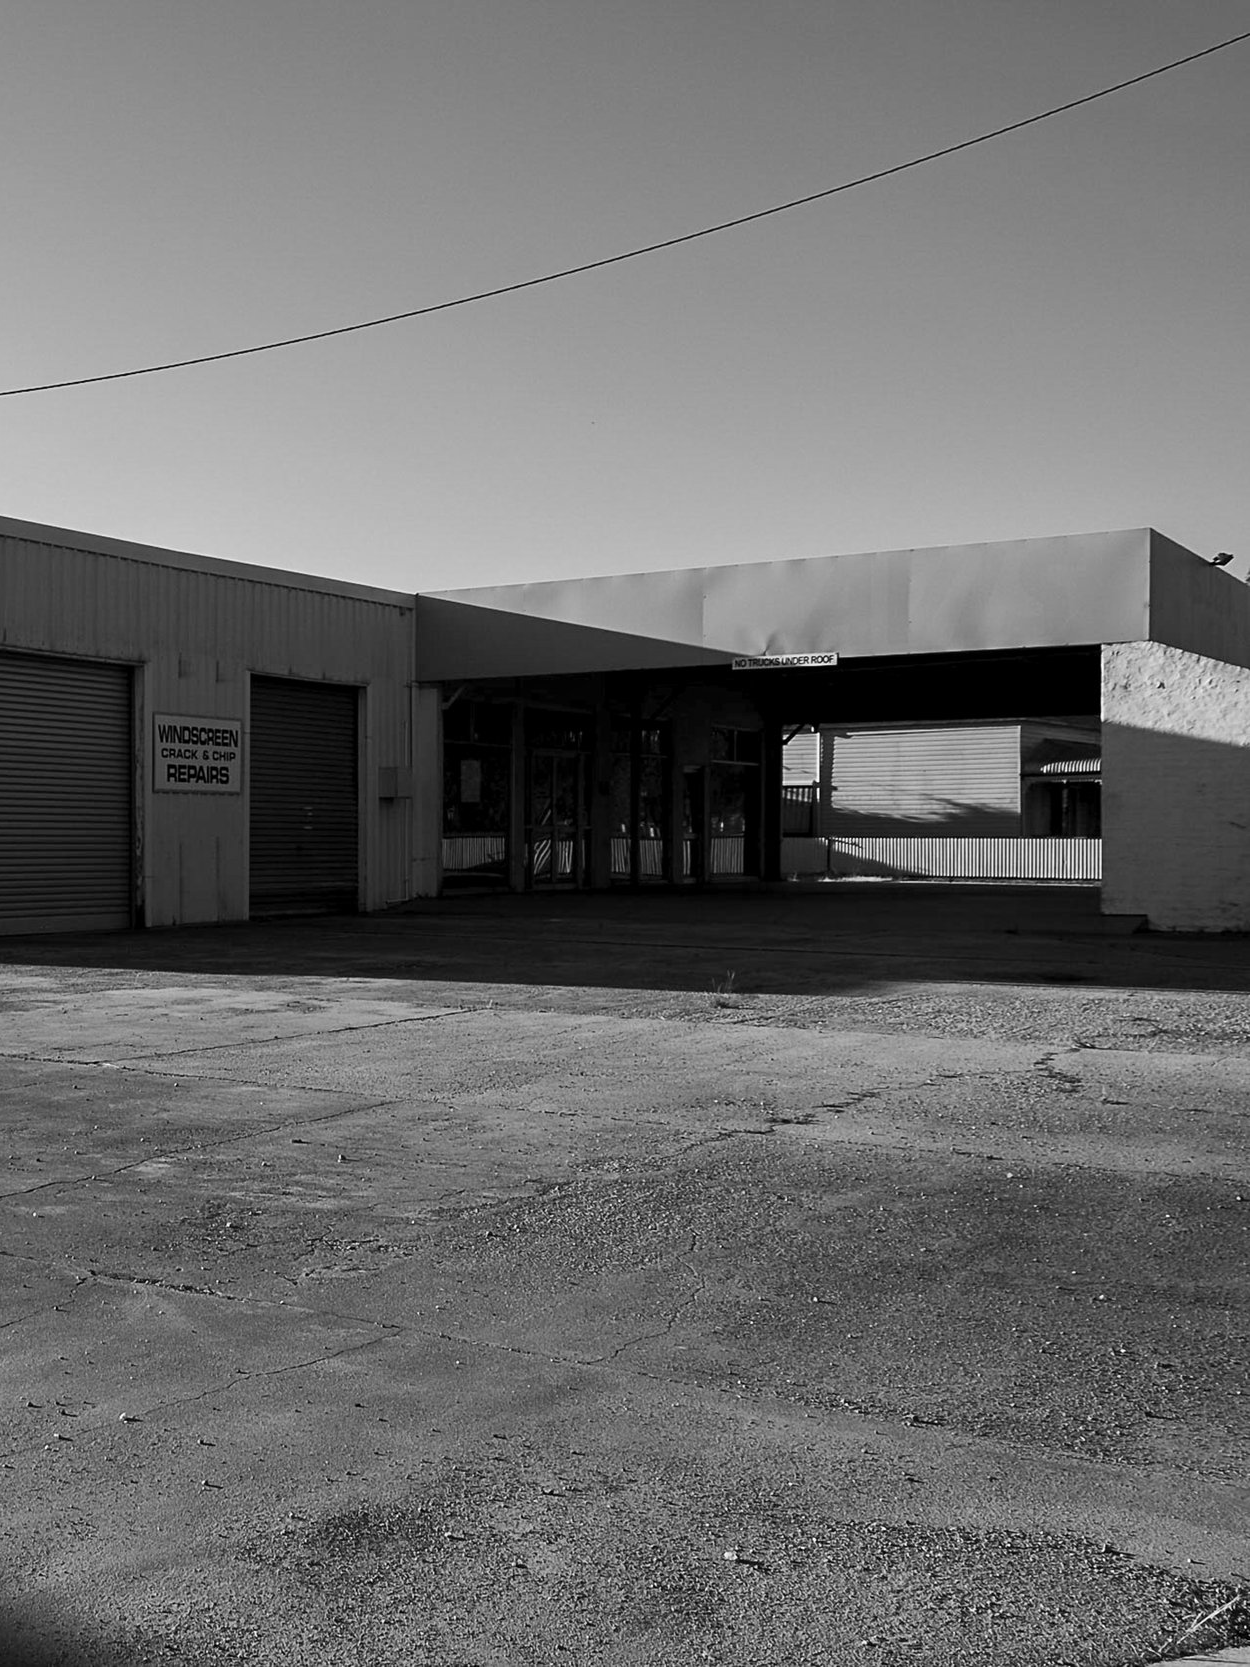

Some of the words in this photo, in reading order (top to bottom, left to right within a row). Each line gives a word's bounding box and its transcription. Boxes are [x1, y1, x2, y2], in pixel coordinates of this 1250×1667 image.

[734, 659, 747, 668] NO
[748, 657, 780, 667] TRUCKS
[781, 656, 810, 666] UNDER
[811, 654, 834, 664] ROOF
[158, 724, 239, 748] WINDSCREEN
[161, 747, 198, 760] CRACK
[202, 750, 209, 760] &
[212, 751, 236, 762] CHIP
[167, 764, 230, 785] REPAIRS
